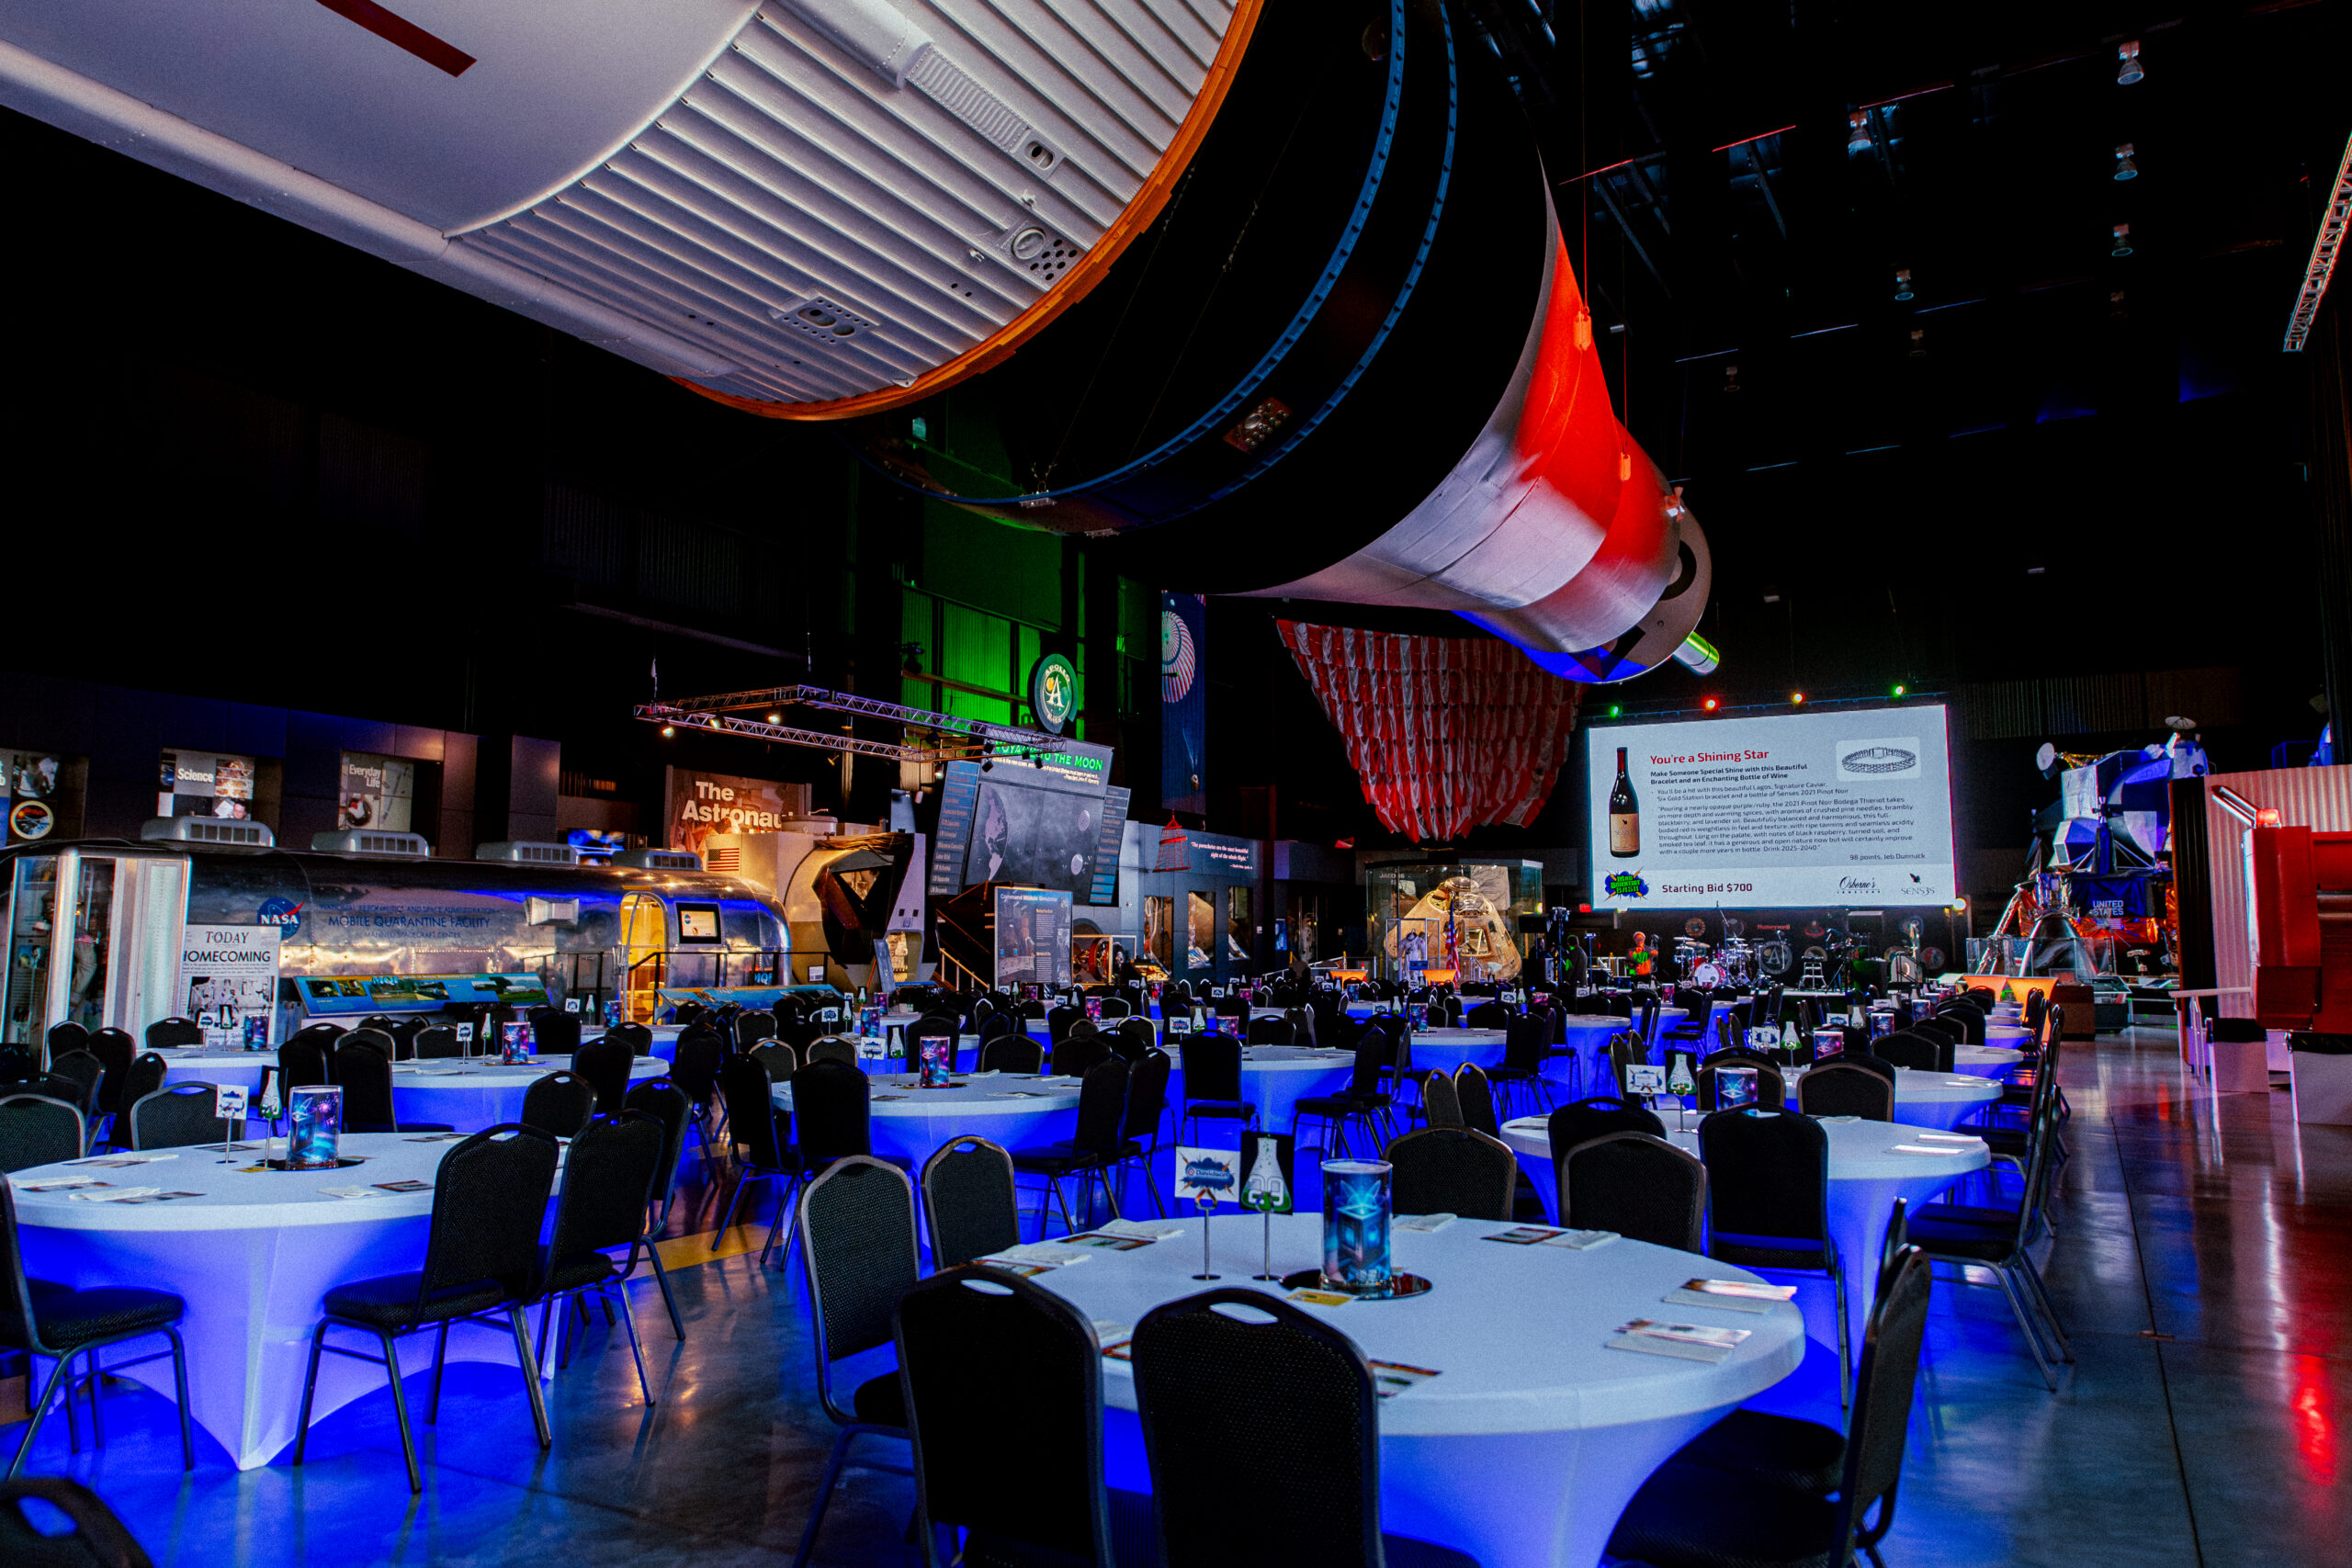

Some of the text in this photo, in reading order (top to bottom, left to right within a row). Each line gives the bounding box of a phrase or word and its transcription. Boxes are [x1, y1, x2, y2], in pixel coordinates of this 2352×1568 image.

[1045, 664, 1070, 682] APOLLO
[1054, 752, 1072, 765] THE
[1074, 755, 1103, 771] MOON
[1650, 754, 1685, 765] You're
[1698, 750, 1741, 764] Shining
[1744, 749, 1769, 759] Star
[177, 768, 214, 782] Science
[349, 764, 381, 778] Everyday
[366, 777, 381, 788] Life
[1702, 775, 1739, 784] Enchanting
[695, 781, 734, 801] The
[681, 800, 793, 829] Astronau
[1662, 884, 1704, 895] Starting
[1727, 883, 1753, 893] $700
[2094, 907, 2124, 916] STATES
[260, 914, 299, 924] NASA
[328, 916, 490, 928] MOBILE QUARANTINE FACILITY
[206, 931, 249, 944] TODAY
